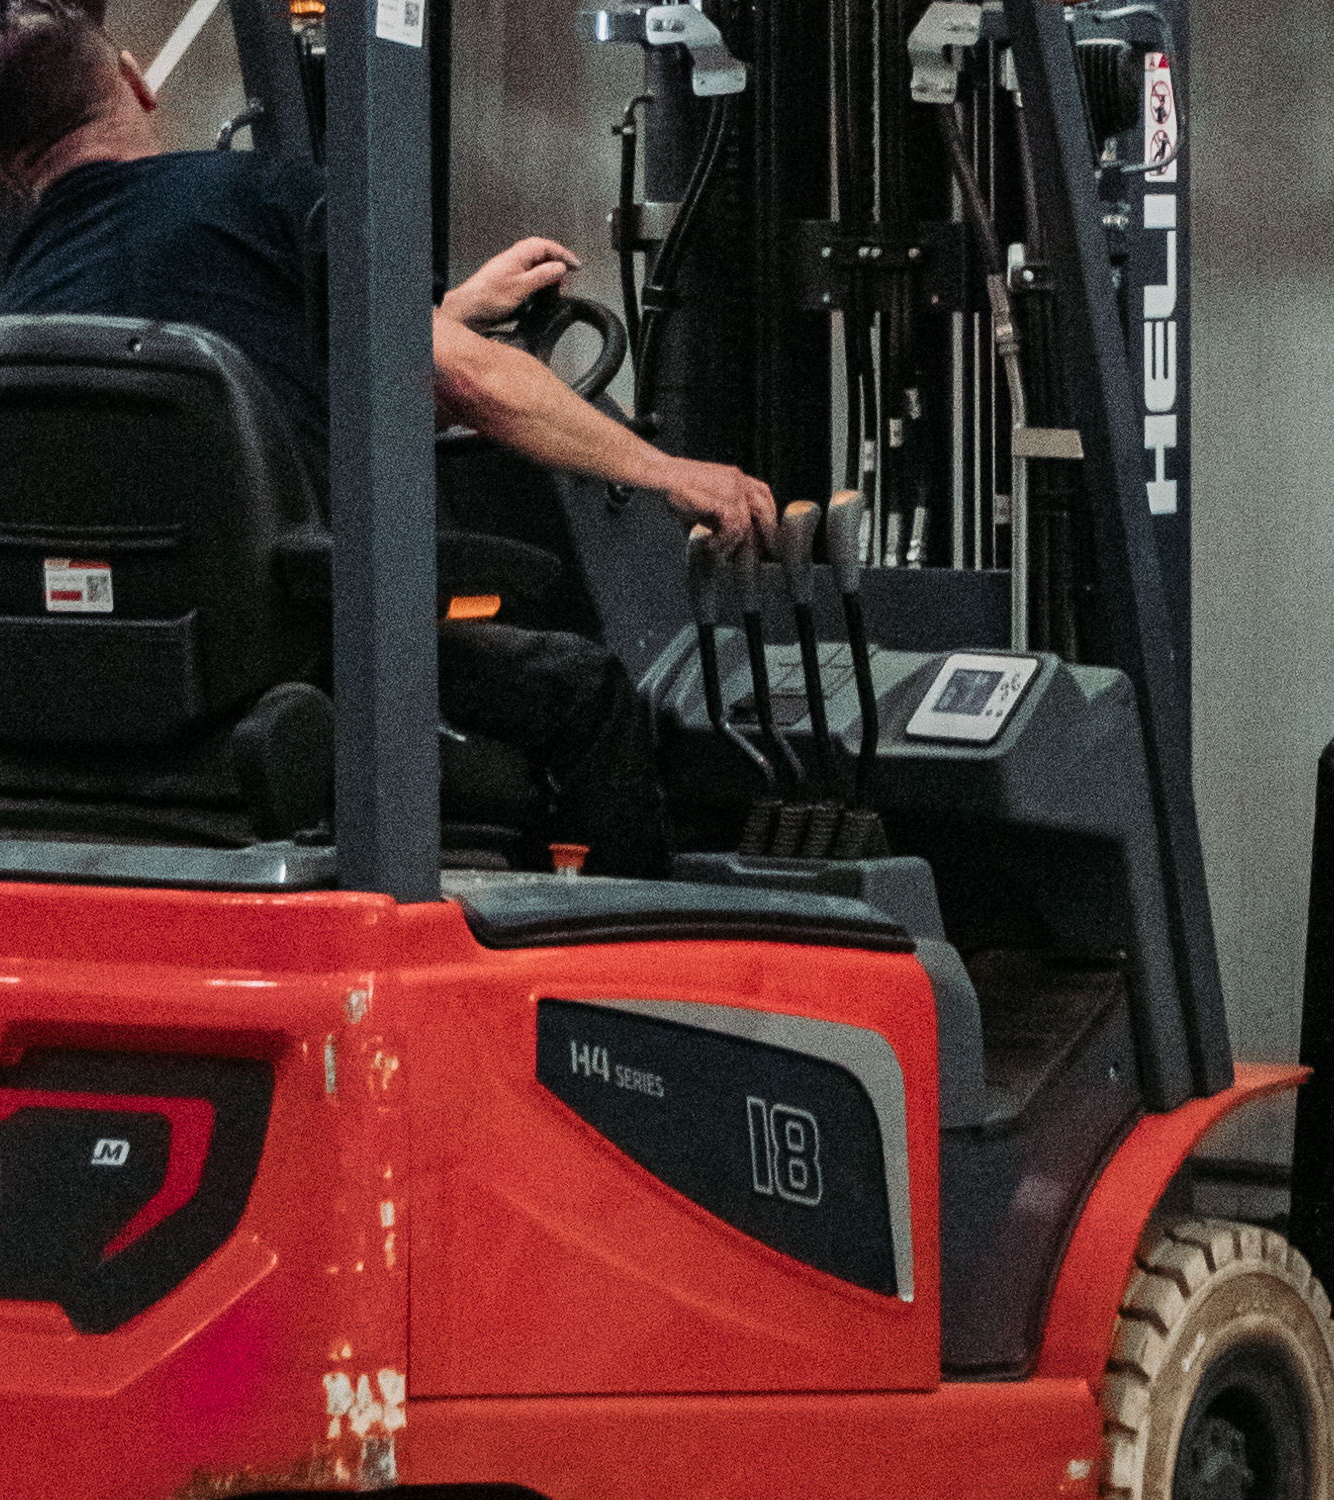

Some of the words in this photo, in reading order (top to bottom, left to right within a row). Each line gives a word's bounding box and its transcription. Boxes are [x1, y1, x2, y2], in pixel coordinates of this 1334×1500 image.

[1143, 193, 1178, 515] HELI
[616, 1064, 665, 1098] SERIES
[746, 1095, 824, 1207] 18
